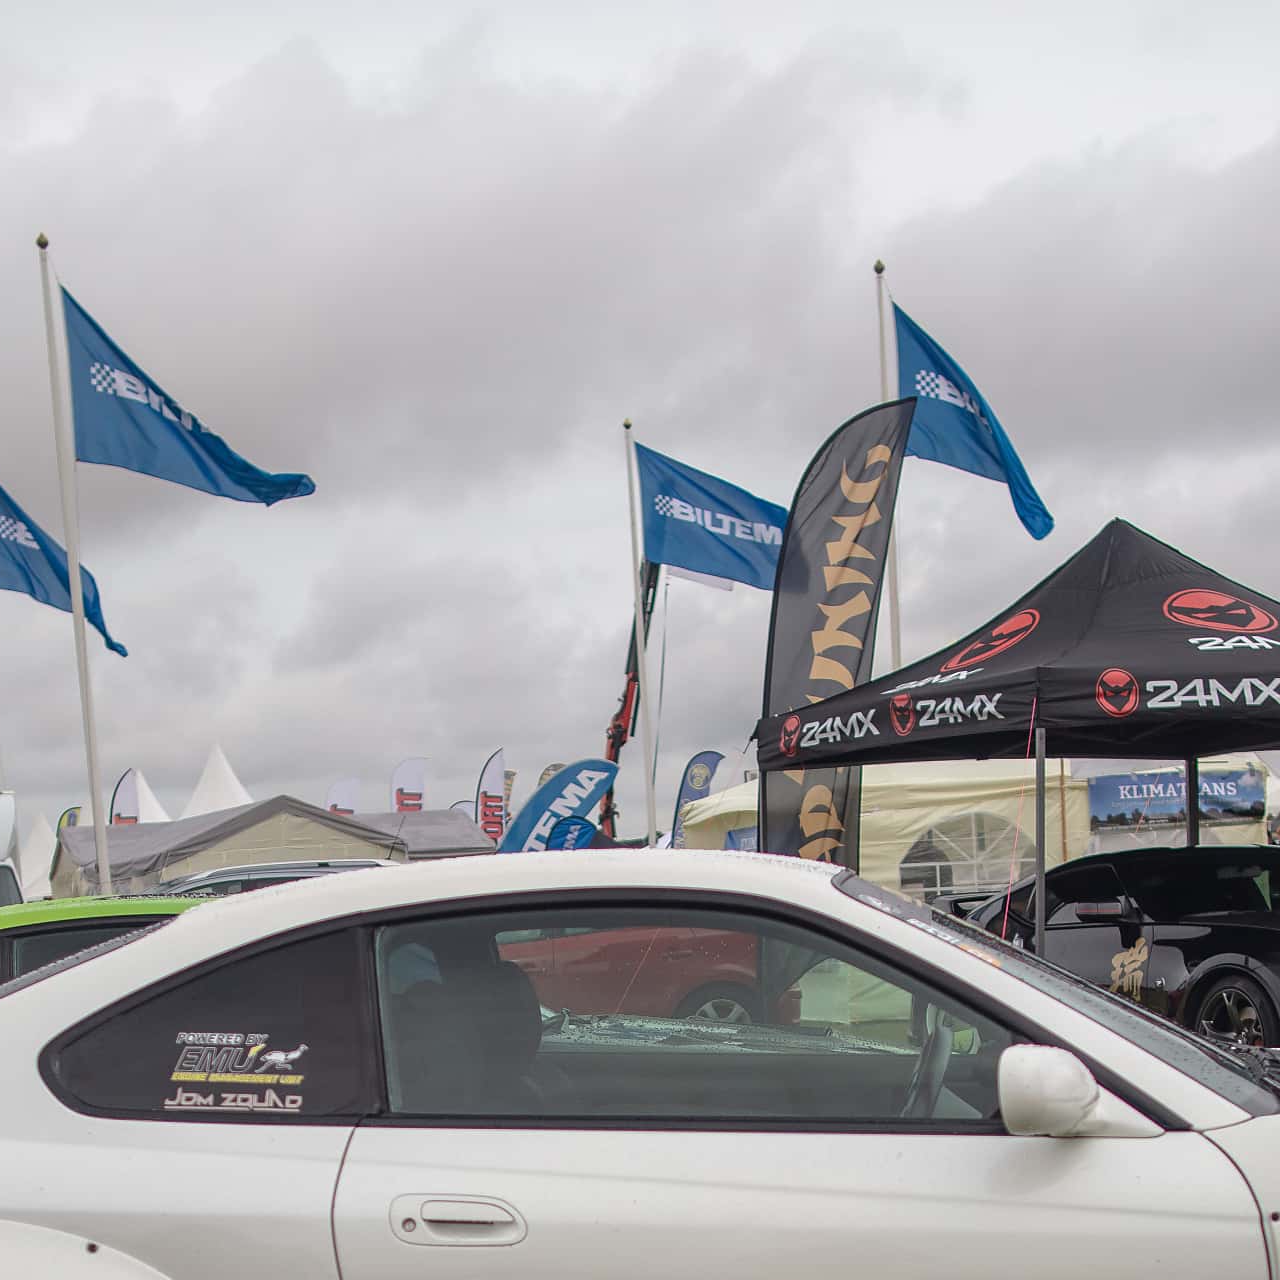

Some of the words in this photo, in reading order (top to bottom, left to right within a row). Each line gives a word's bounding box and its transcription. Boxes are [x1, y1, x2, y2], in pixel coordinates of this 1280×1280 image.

[671, 497, 783, 545] BILTEM
[916, 693, 1006, 727] 24MX
[800, 708, 881, 748] 24MX
[1118, 781, 1238, 800] KLIMATANS
[175, 1032, 244, 1045] POWERED
[244, 1033, 269, 1045] BY
[174, 1046, 261, 1073] EMU
